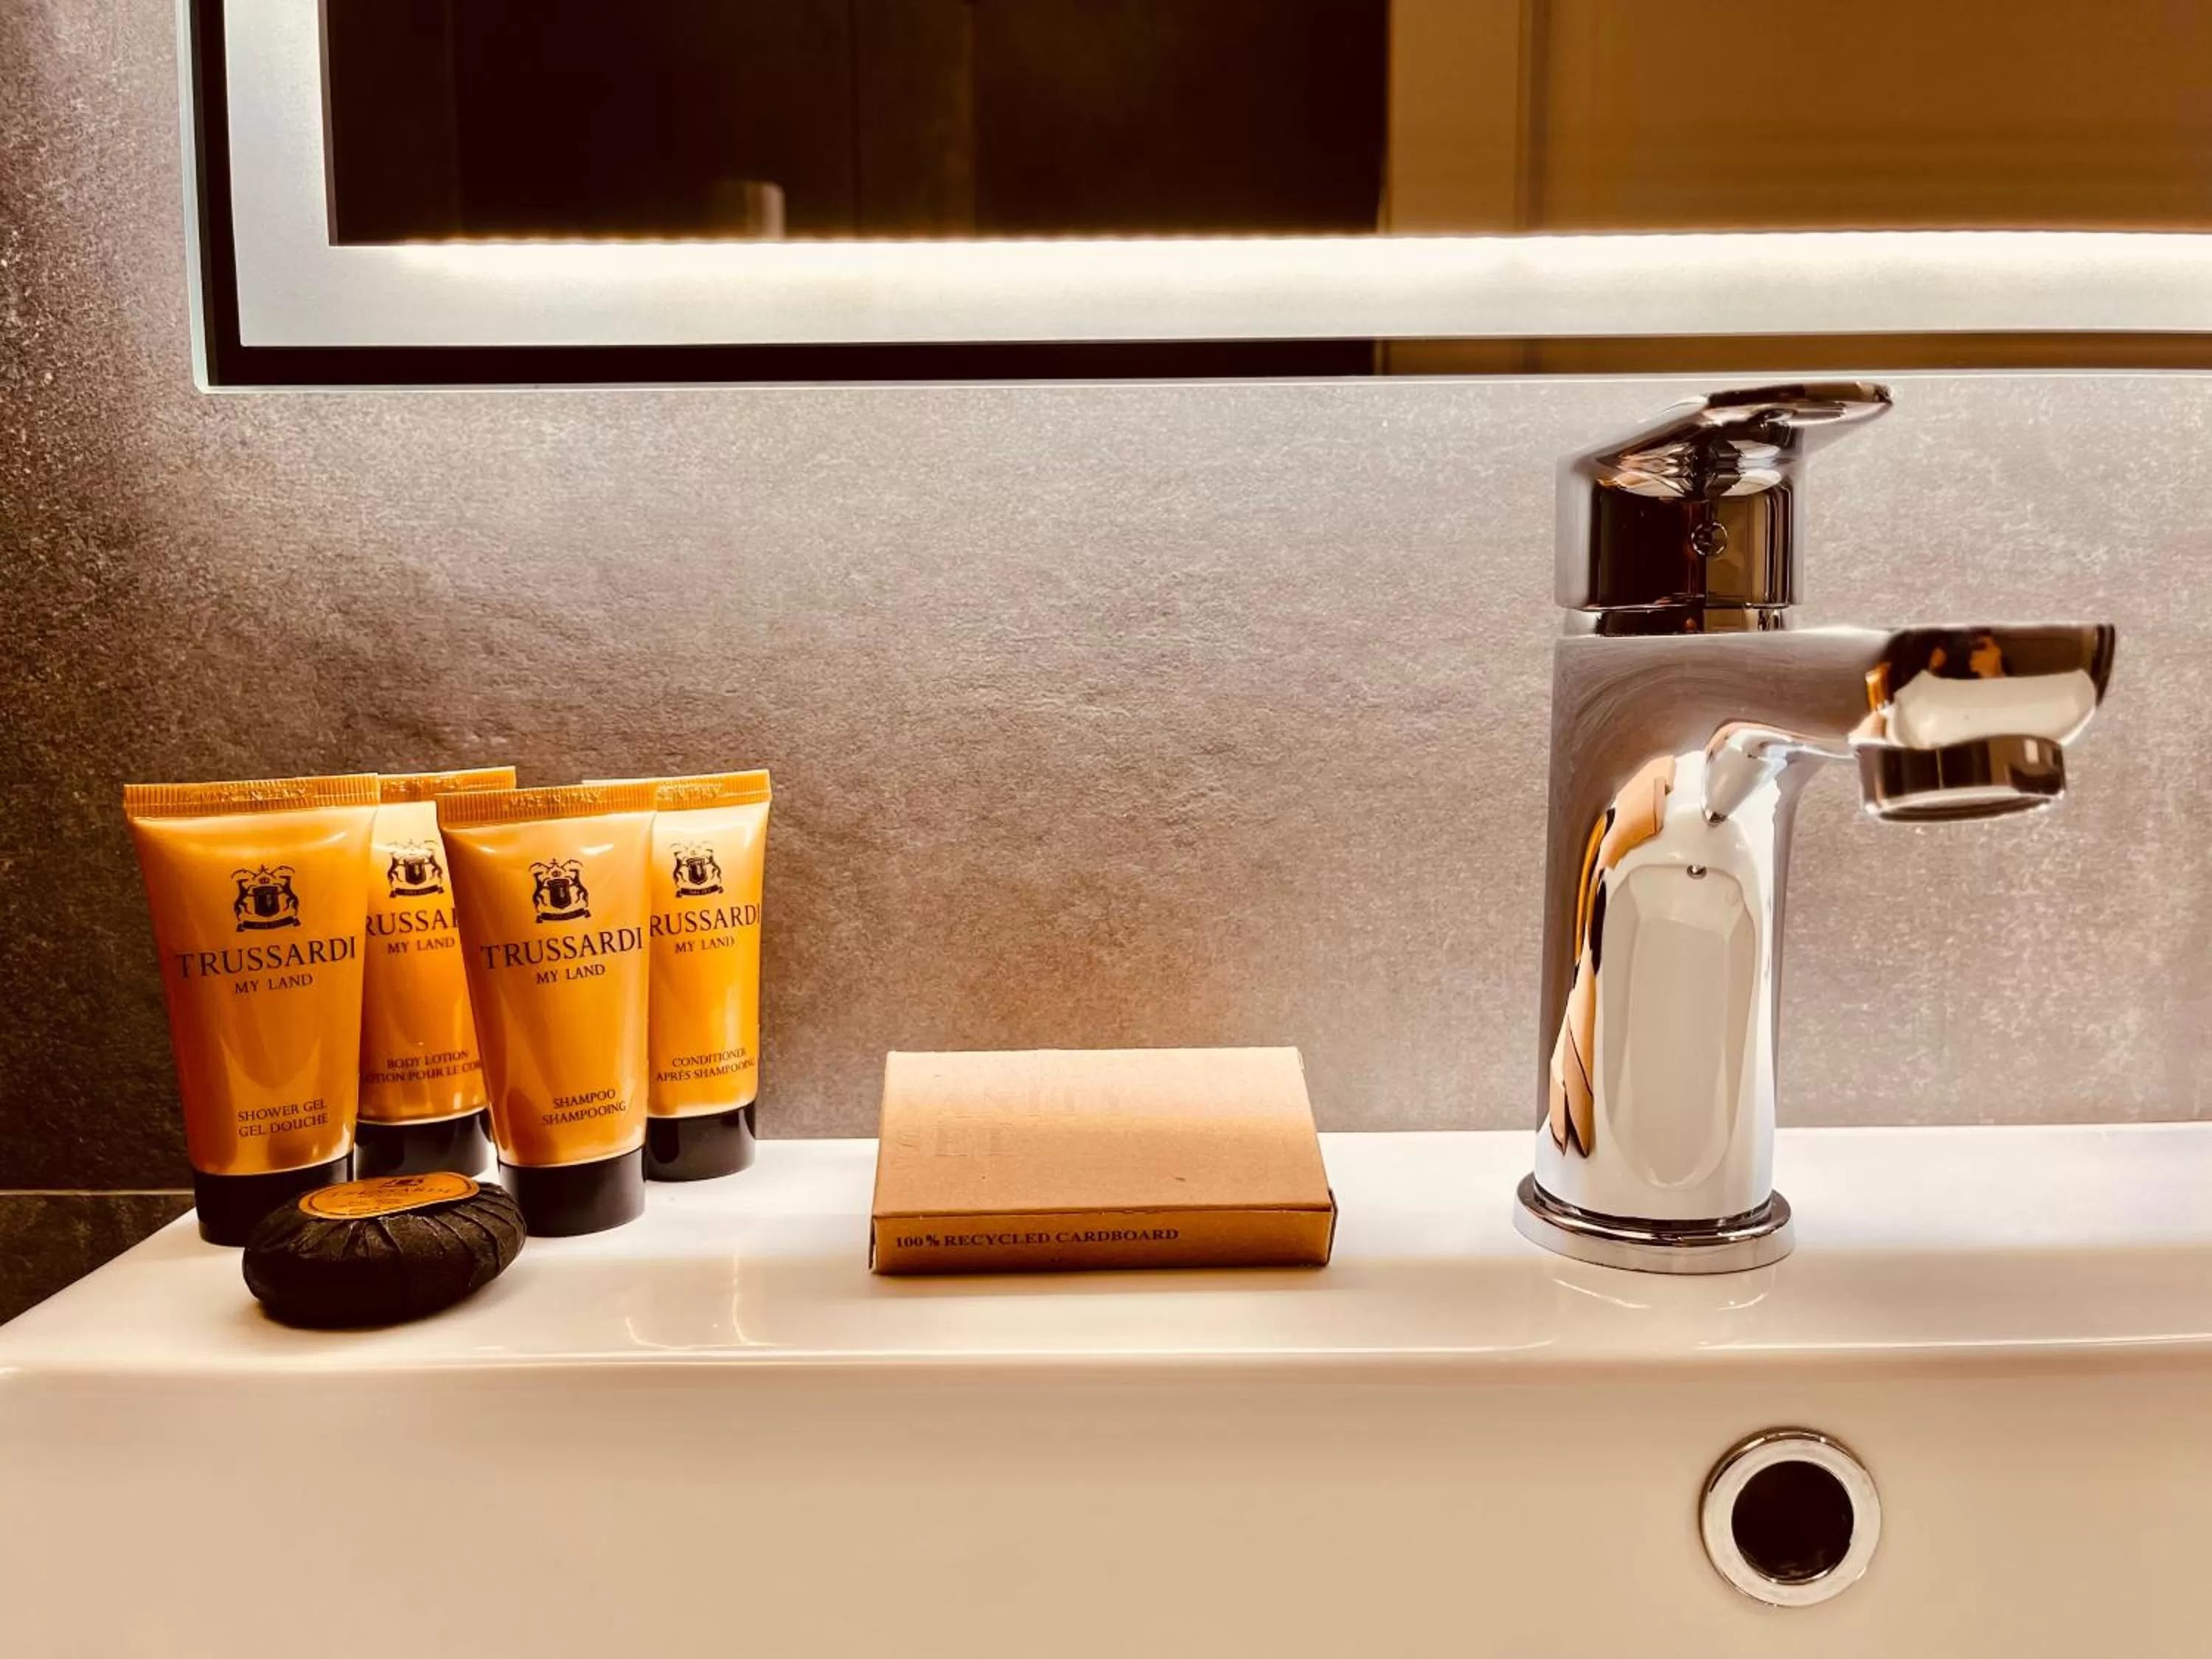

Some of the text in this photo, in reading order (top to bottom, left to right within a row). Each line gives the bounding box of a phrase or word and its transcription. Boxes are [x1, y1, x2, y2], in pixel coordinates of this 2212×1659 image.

[366, 908, 459, 936] RUSSA
[650, 902, 761, 937] RUSSARDI
[387, 936, 456, 955] MY LAND
[480, 926, 643, 970] TRUSSARDI
[675, 936, 735, 954] MY LAND
[175, 936, 356, 978] TRUSSARDI
[234, 973, 313, 995] MY LAND
[536, 964, 605, 985] MY LAND
[386, 1049, 470, 1069] BODY LOTION
[366, 1071, 406, 1083] OTION
[408, 1069, 444, 1082] POUR
[237, 1098, 327, 1122] SHOWER GEL
[553, 1088, 616, 1110] SHAMPOO
[237, 1112, 329, 1137] GEL DOUCHE
[542, 1102, 627, 1126] SHAMPOOING
[944, 1232, 1051, 1248] RECYCLED
[1055, 1228, 1180, 1245] CARDBOARD
